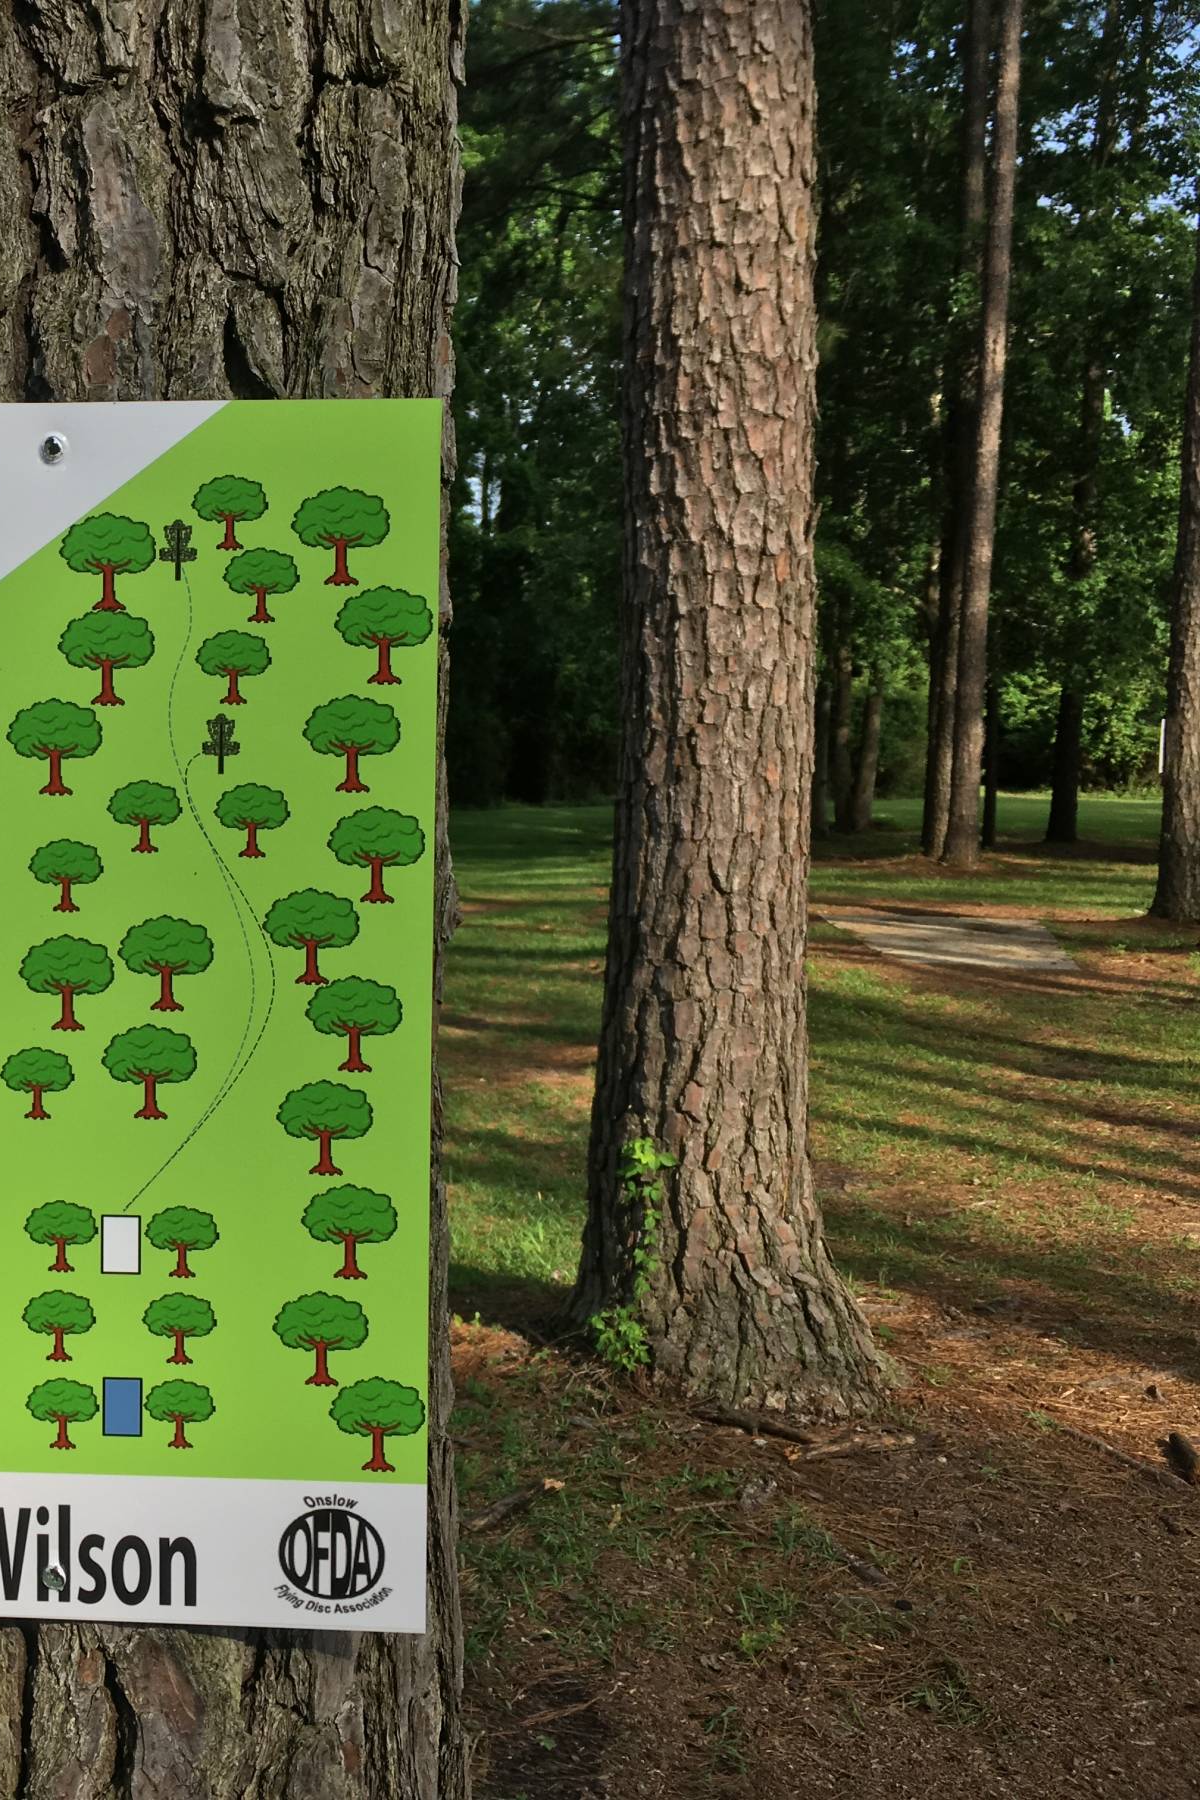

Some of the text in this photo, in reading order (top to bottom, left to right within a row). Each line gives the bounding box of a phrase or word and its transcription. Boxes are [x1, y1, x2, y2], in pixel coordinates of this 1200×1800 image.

[302, 1493, 359, 1509] Onslow
[280, 1509, 385, 1600] OFDA
[273, 1583, 394, 1614] Flying Disc Association
